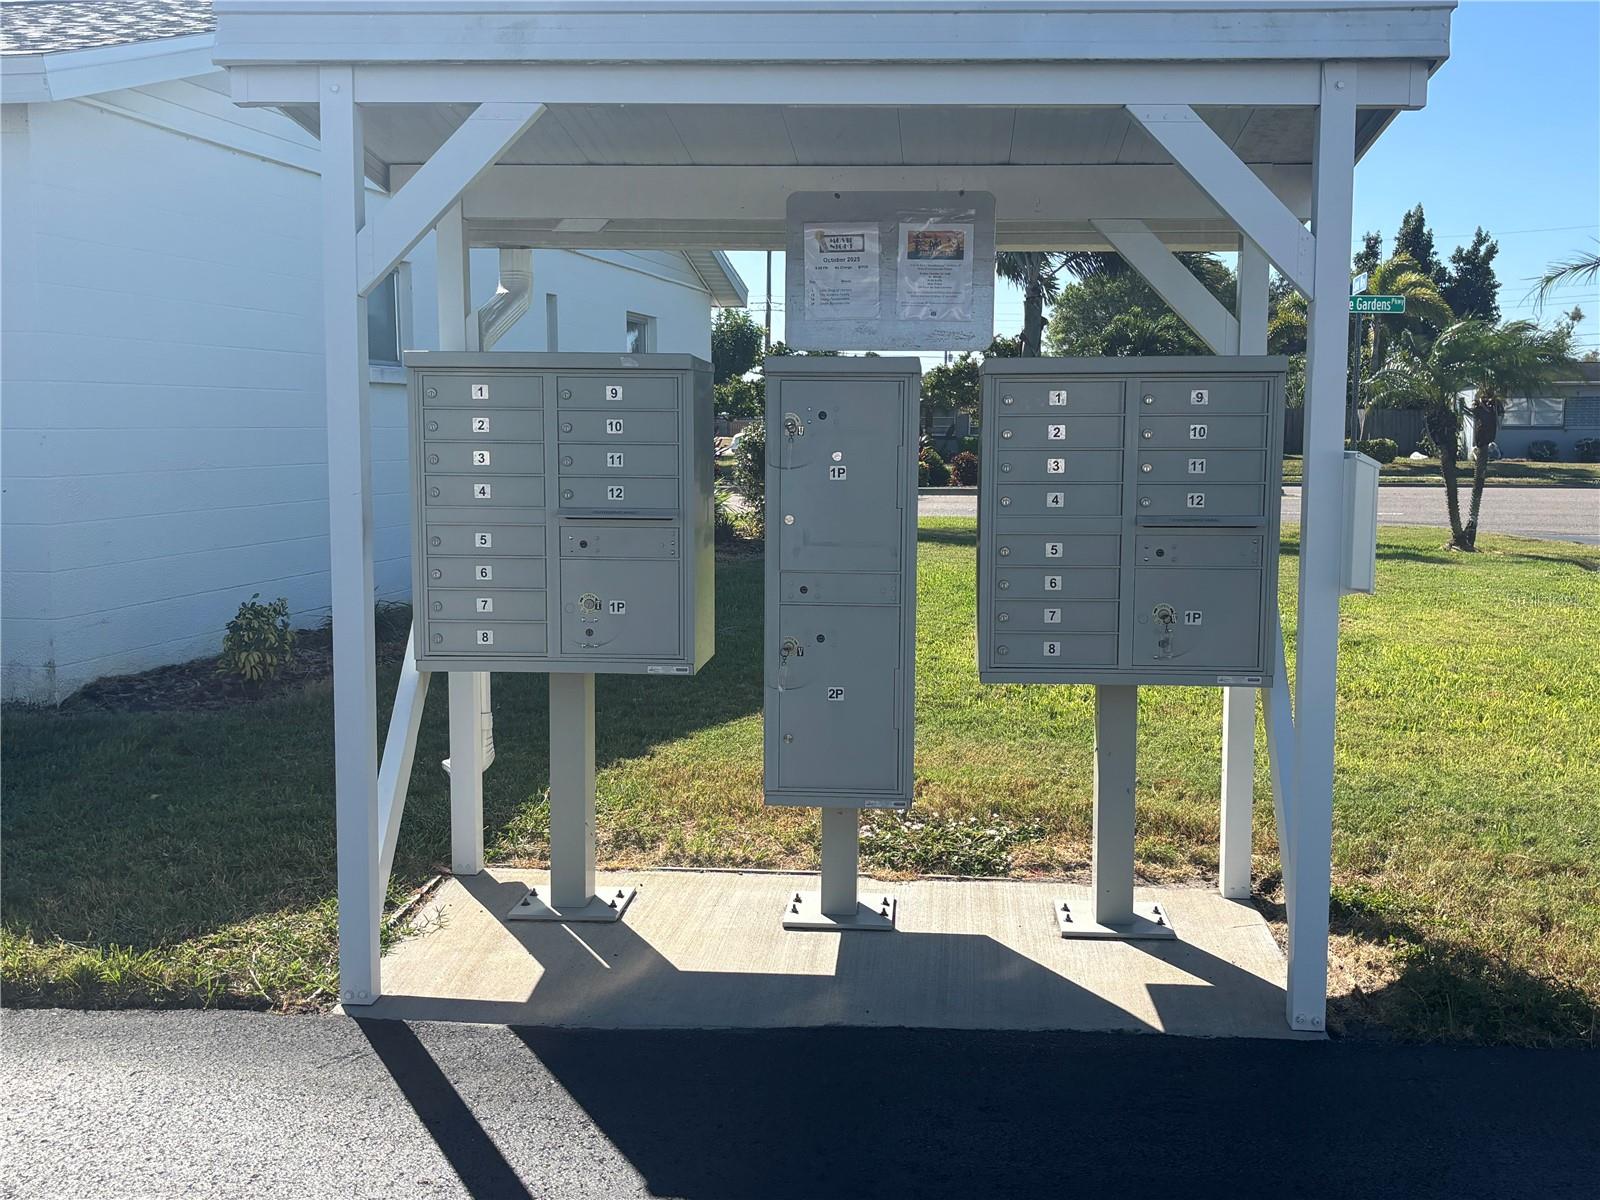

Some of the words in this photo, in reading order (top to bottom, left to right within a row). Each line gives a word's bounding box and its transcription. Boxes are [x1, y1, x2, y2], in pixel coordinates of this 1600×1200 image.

[1356, 298, 1391, 311] Gardens
[1391, 298, 1405, 306] Pkwy
[610, 387, 618, 399] 9
[1195, 391, 1204, 403] 9
[477, 419, 485, 431] 2
[607, 421, 622, 432] 10
[1053, 426, 1061, 438] 2
[1191, 426, 1206, 438] 10
[477, 452, 485, 464] 3
[609, 454, 622, 466] 11
[1052, 460, 1060, 472] 3
[1190, 460, 1204, 472] 11
[830, 467, 846, 479] 1P
[478, 485, 487, 497] 4
[607, 487, 623, 499] 12
[1051, 494, 1059, 505] 4
[1188, 494, 1204, 506] 12
[480, 534, 487, 546] 5
[1050, 544, 1058, 556] 5
[480, 567, 488, 578] 6
[1049, 577, 1057, 589] 6
[481, 599, 488, 610] 7
[609, 602, 625, 613] 1P
[1048, 610, 1057, 621] 7
[1185, 612, 1201, 623] 1P
[481, 631, 489, 643] 8
[1048, 643, 1056, 655] 8
[828, 688, 844, 699] 2P
